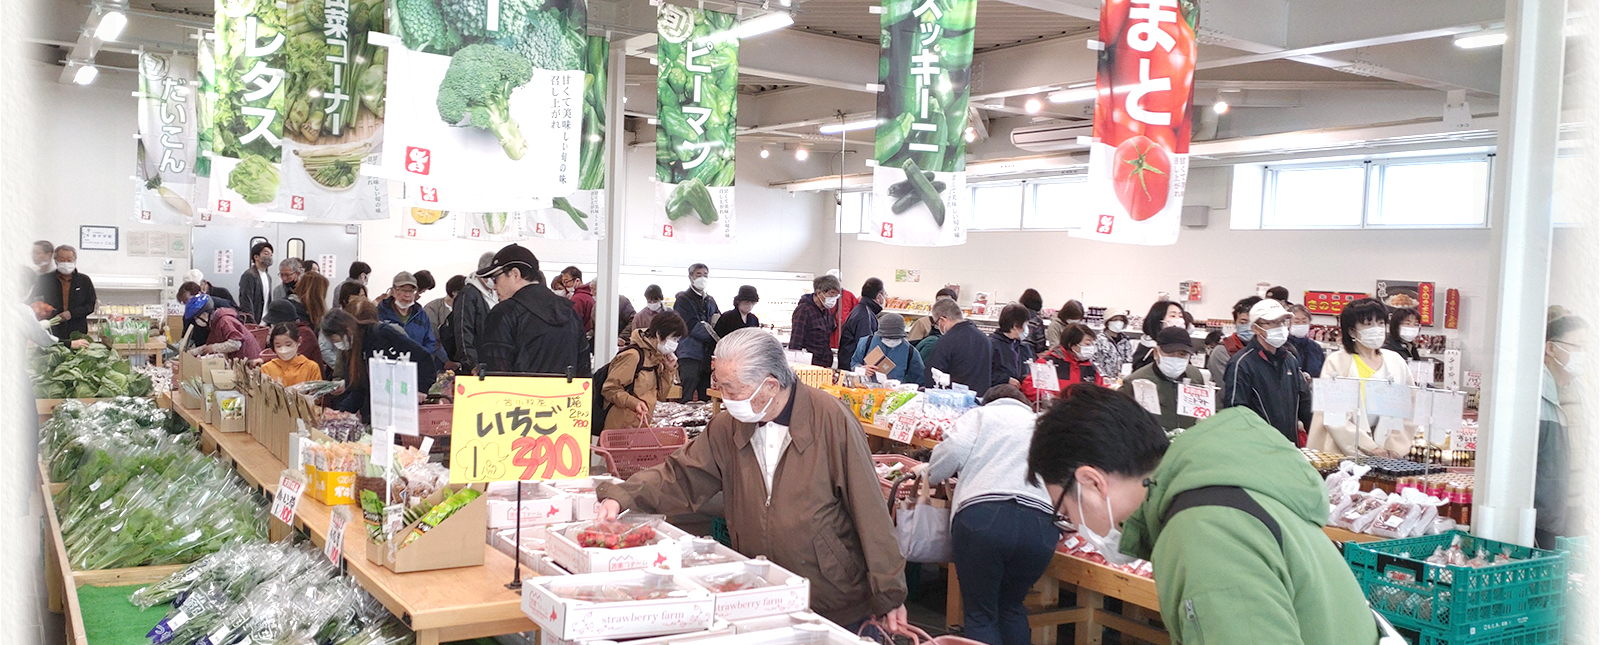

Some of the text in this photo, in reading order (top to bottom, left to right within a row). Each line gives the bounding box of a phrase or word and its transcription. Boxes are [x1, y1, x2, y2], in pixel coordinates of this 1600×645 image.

[239, 16, 286, 148] レタス
[324, 0, 349, 135] 菜コーナー
[550, 75, 561, 129] 召し上がれ
[160, 77, 188, 173] だいこん
[559, 74, 572, 184] 甘くて美味しい旬の味
[682, 41, 713, 170] ピーマン
[1308, 299, 1349, 312] きのこ
[477, 405, 562, 437] いちご
[602, 611, 684, 624] strawberry farm
[717, 598, 783, 612] trawberry farm
